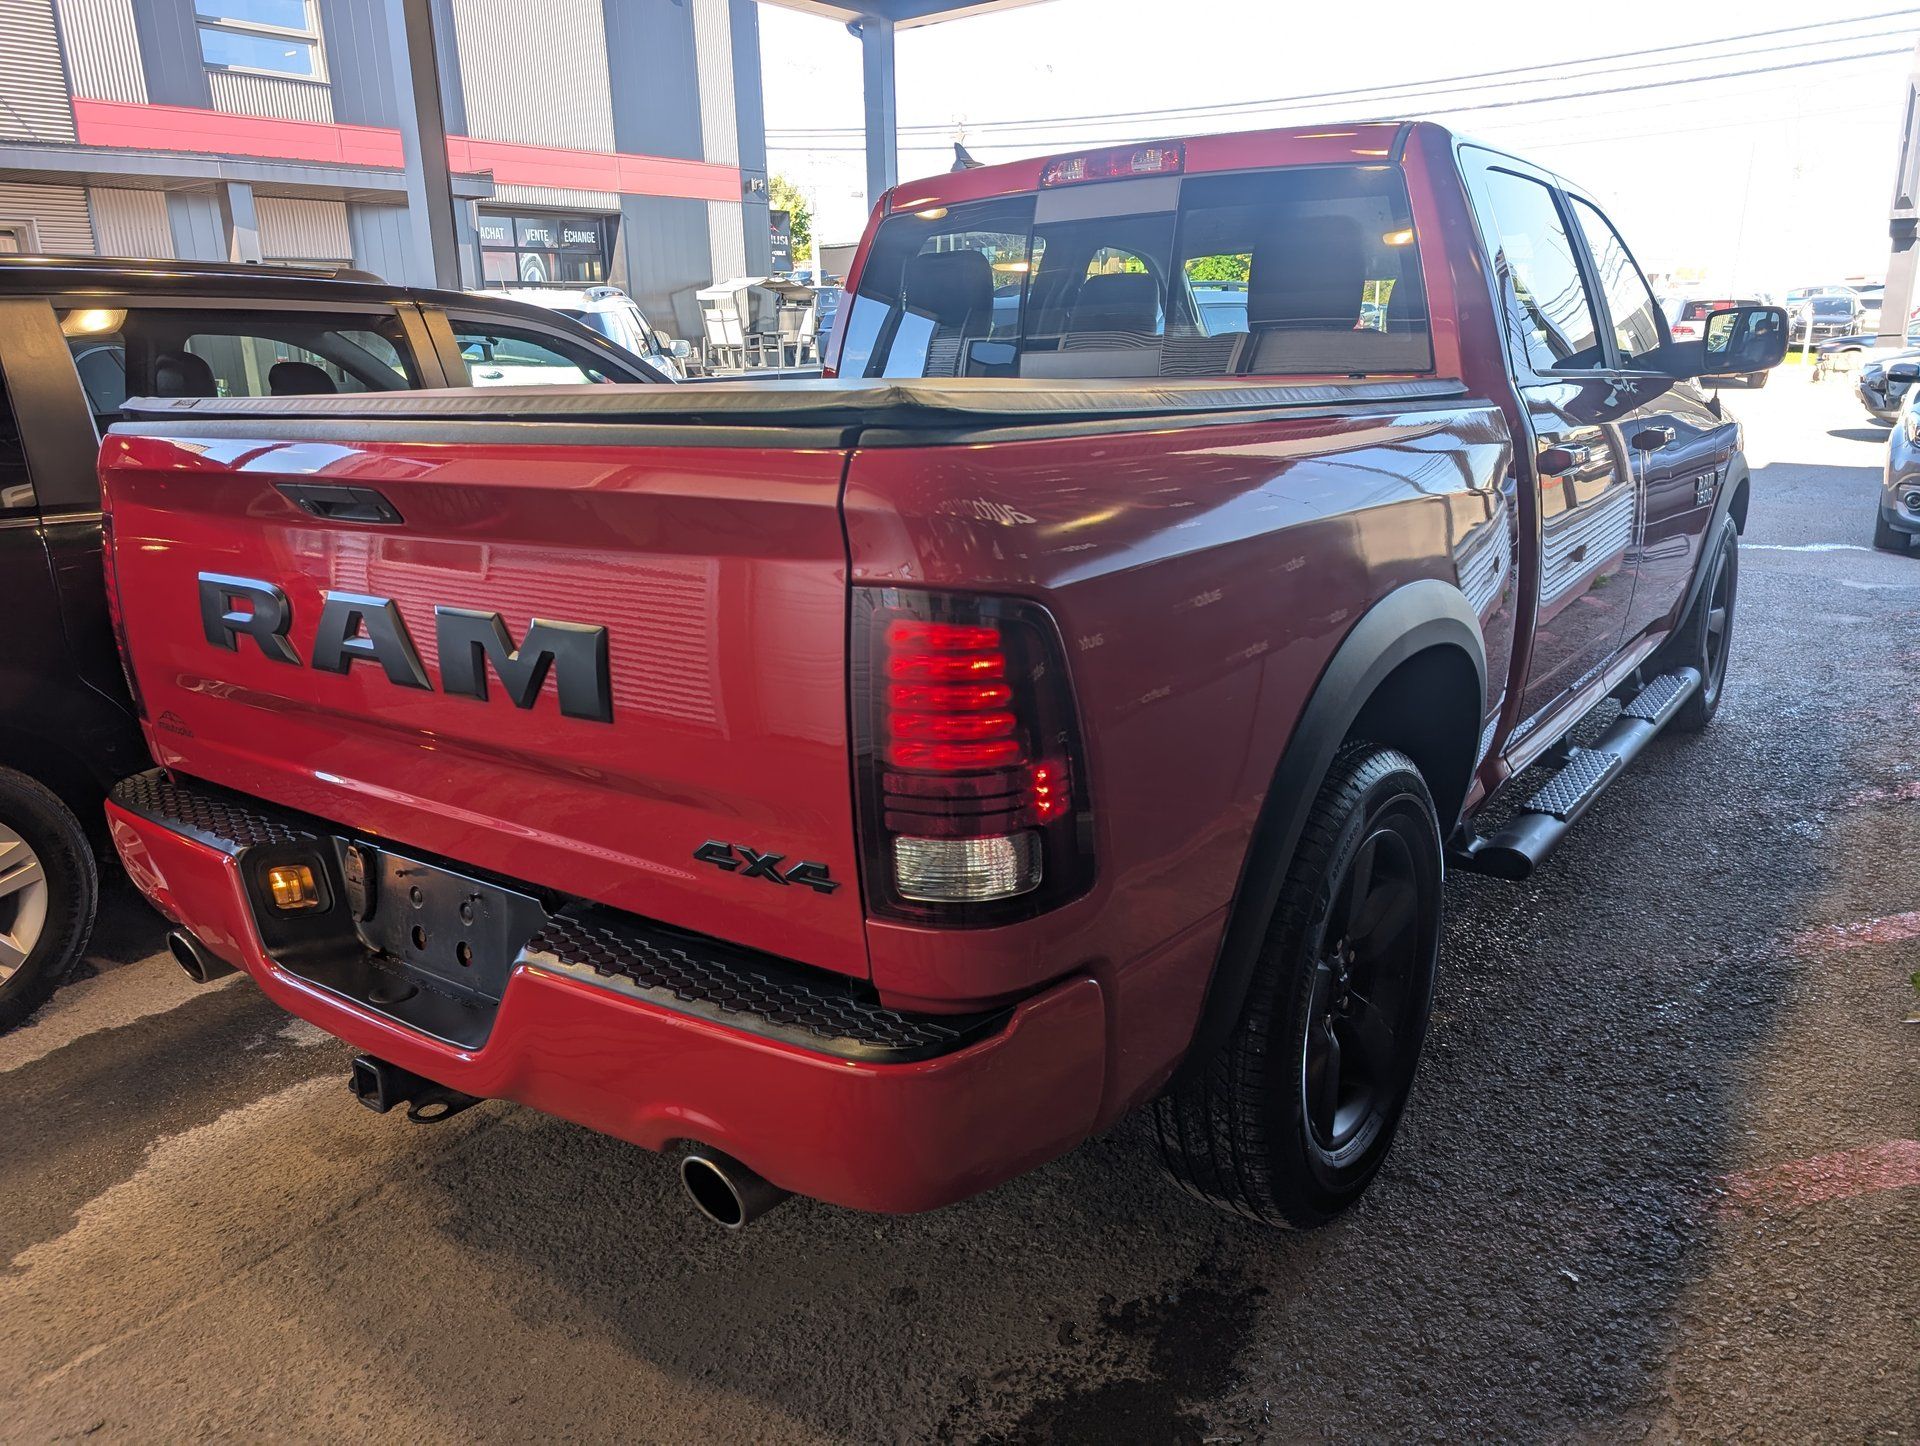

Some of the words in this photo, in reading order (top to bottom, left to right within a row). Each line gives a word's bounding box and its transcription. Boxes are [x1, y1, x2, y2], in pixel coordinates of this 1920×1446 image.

[480, 227, 504, 240] ACHAT
[525, 229, 549, 241] VENTE
[564, 228, 596, 243] ÉCHANGE
[198, 571, 615, 724] RAM
[692, 839, 842, 895] 4X4
